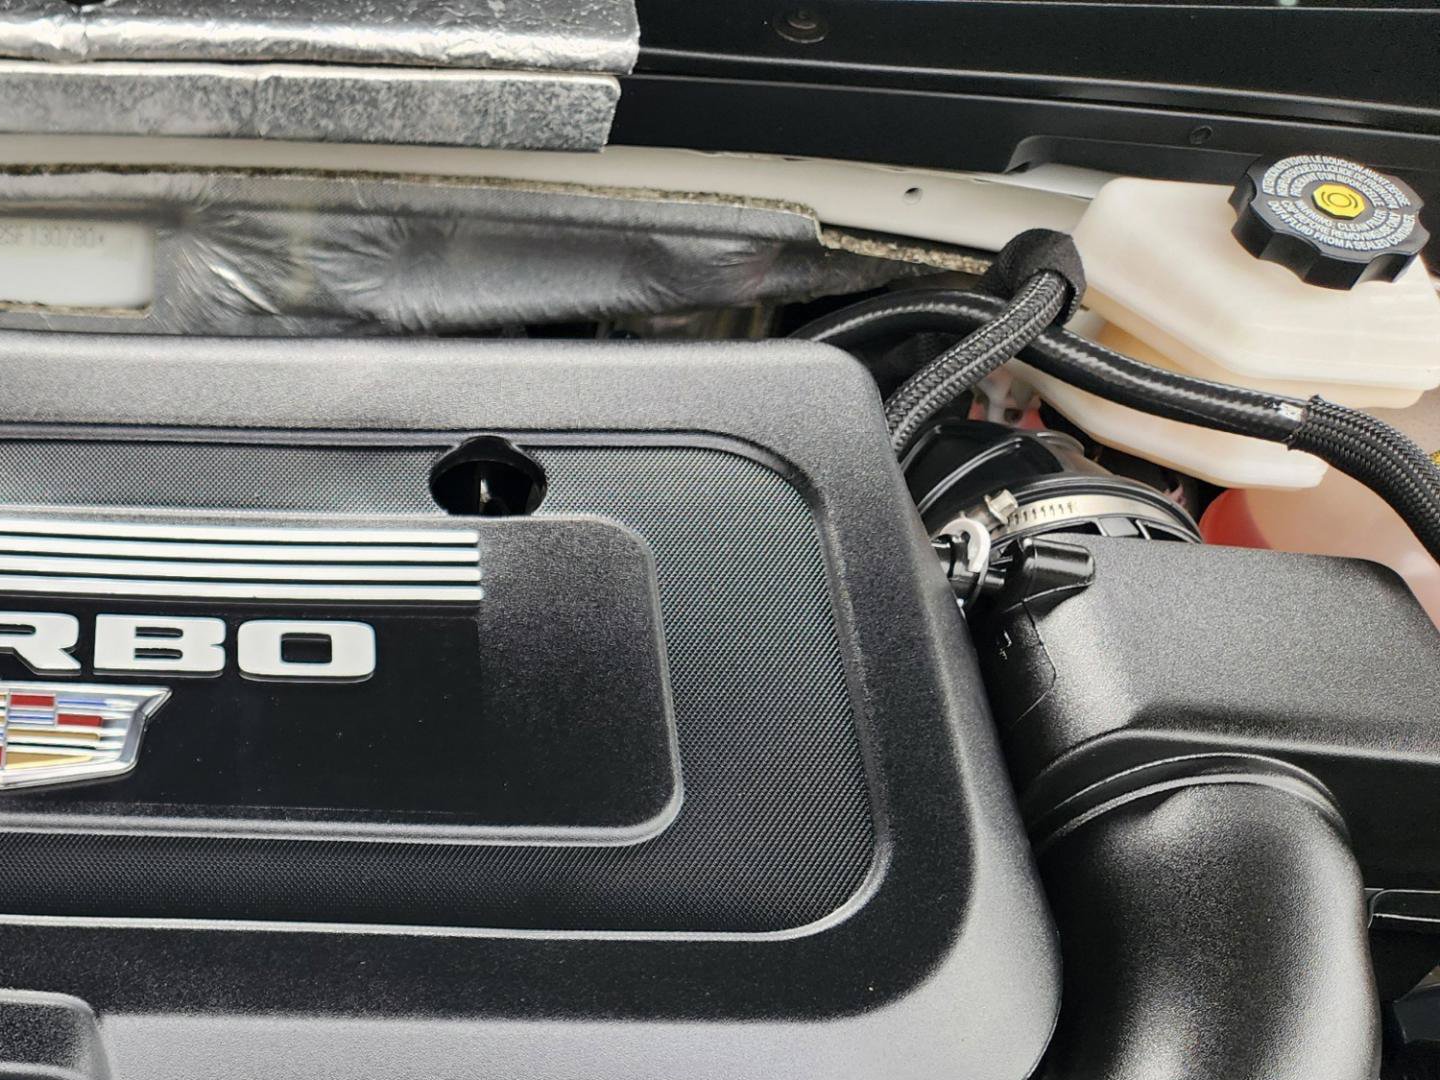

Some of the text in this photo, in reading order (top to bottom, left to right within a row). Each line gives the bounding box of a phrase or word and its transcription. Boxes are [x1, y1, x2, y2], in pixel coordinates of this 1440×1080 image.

[1320, 163, 1355, 176] LIQUIDE
[1353, 170, 1369, 181] DE
[1363, 176, 1390, 194] FREIN
[1282, 216, 1315, 237] FLUID
[1311, 231, 1344, 248] FROM
[1352, 237, 1393, 250] SEALED
[1291, 212, 1331, 236] BEFORE
[1336, 222, 1373, 232] CLEAN
